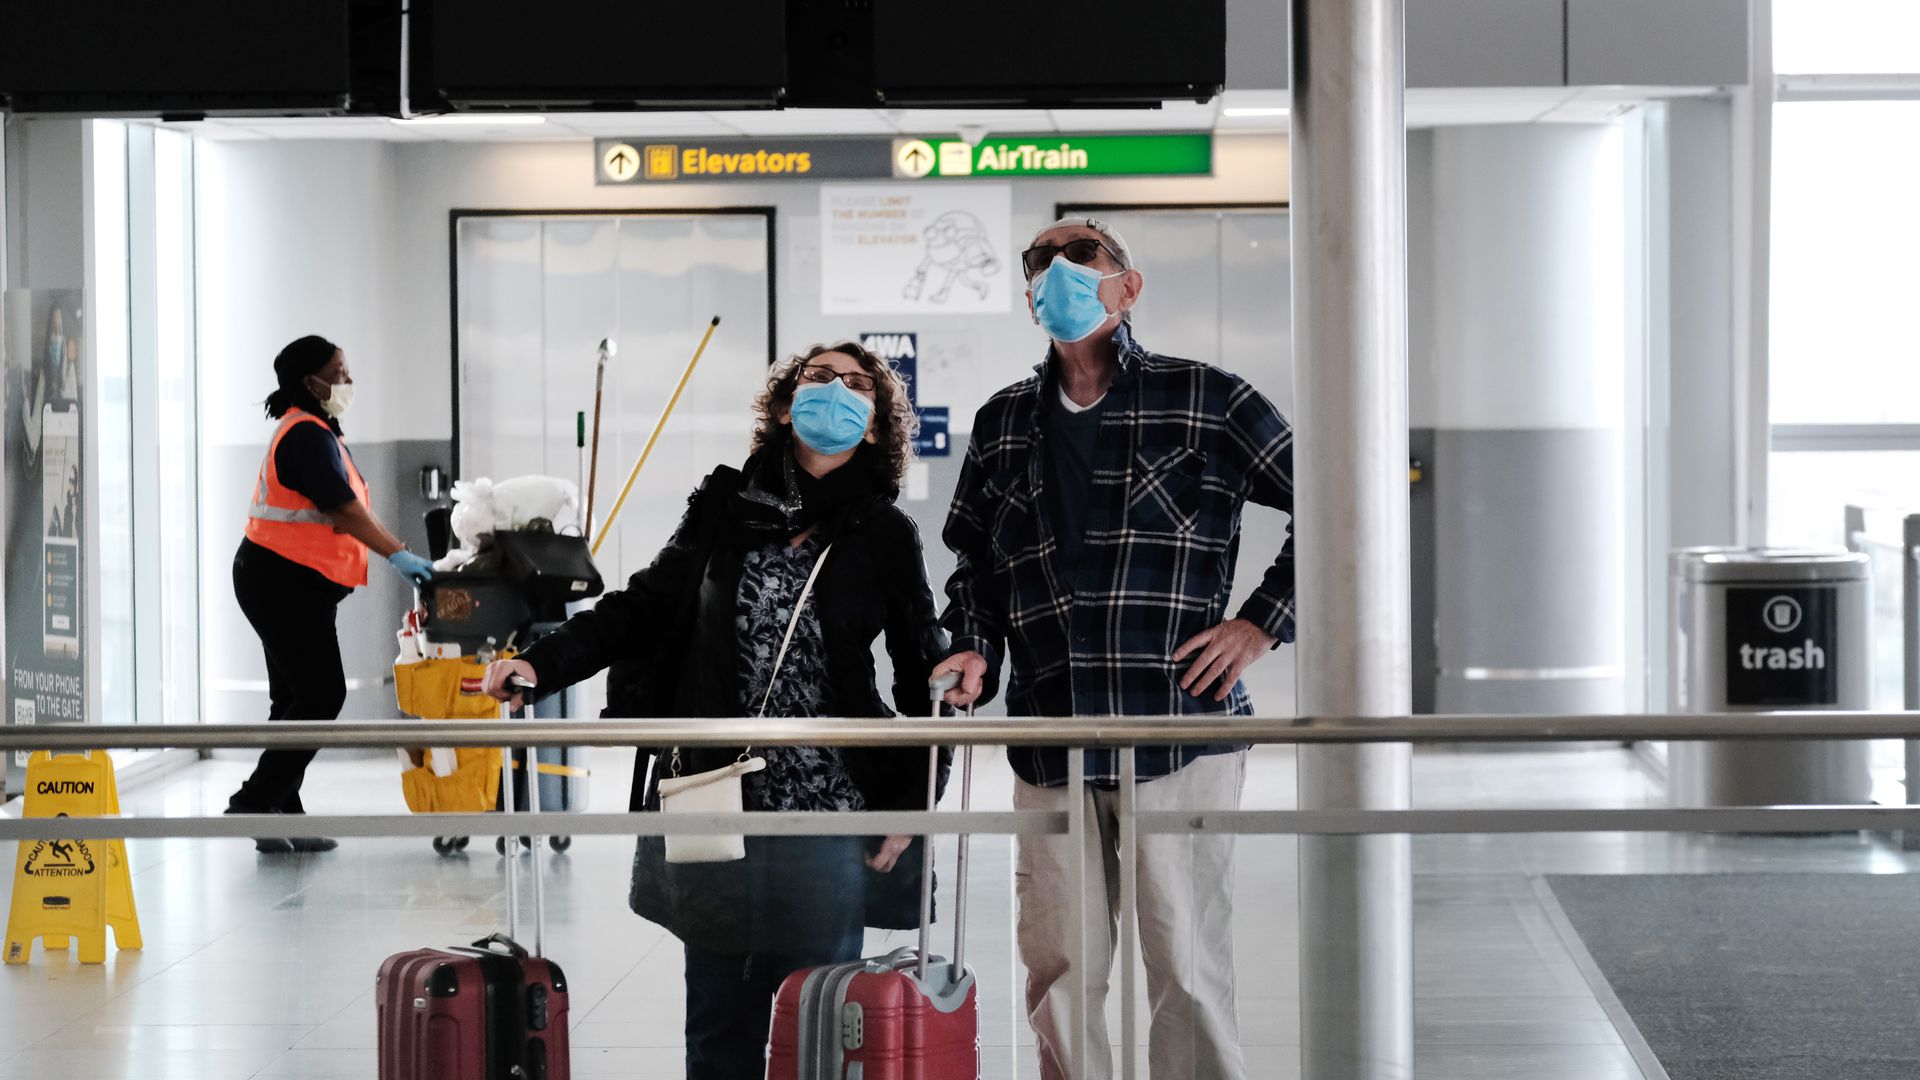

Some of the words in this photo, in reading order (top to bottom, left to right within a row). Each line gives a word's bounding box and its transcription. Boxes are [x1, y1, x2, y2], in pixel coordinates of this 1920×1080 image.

[682, 147, 811, 174] Elevators
[977, 143, 1088, 170] AirTrain
[857, 234, 918, 245] ELEVATOR
[1739, 638, 1825, 669] trash
[14, 668, 34, 690] FROM
[34, 671, 55, 693] YOUR
[36, 693, 46, 715] TO
[46, 695, 61, 717] THE
[37, 781, 94, 794] CAUTION
[28, 839, 47, 861] CAUT
[34, 868, 83, 877] ATTENTION
